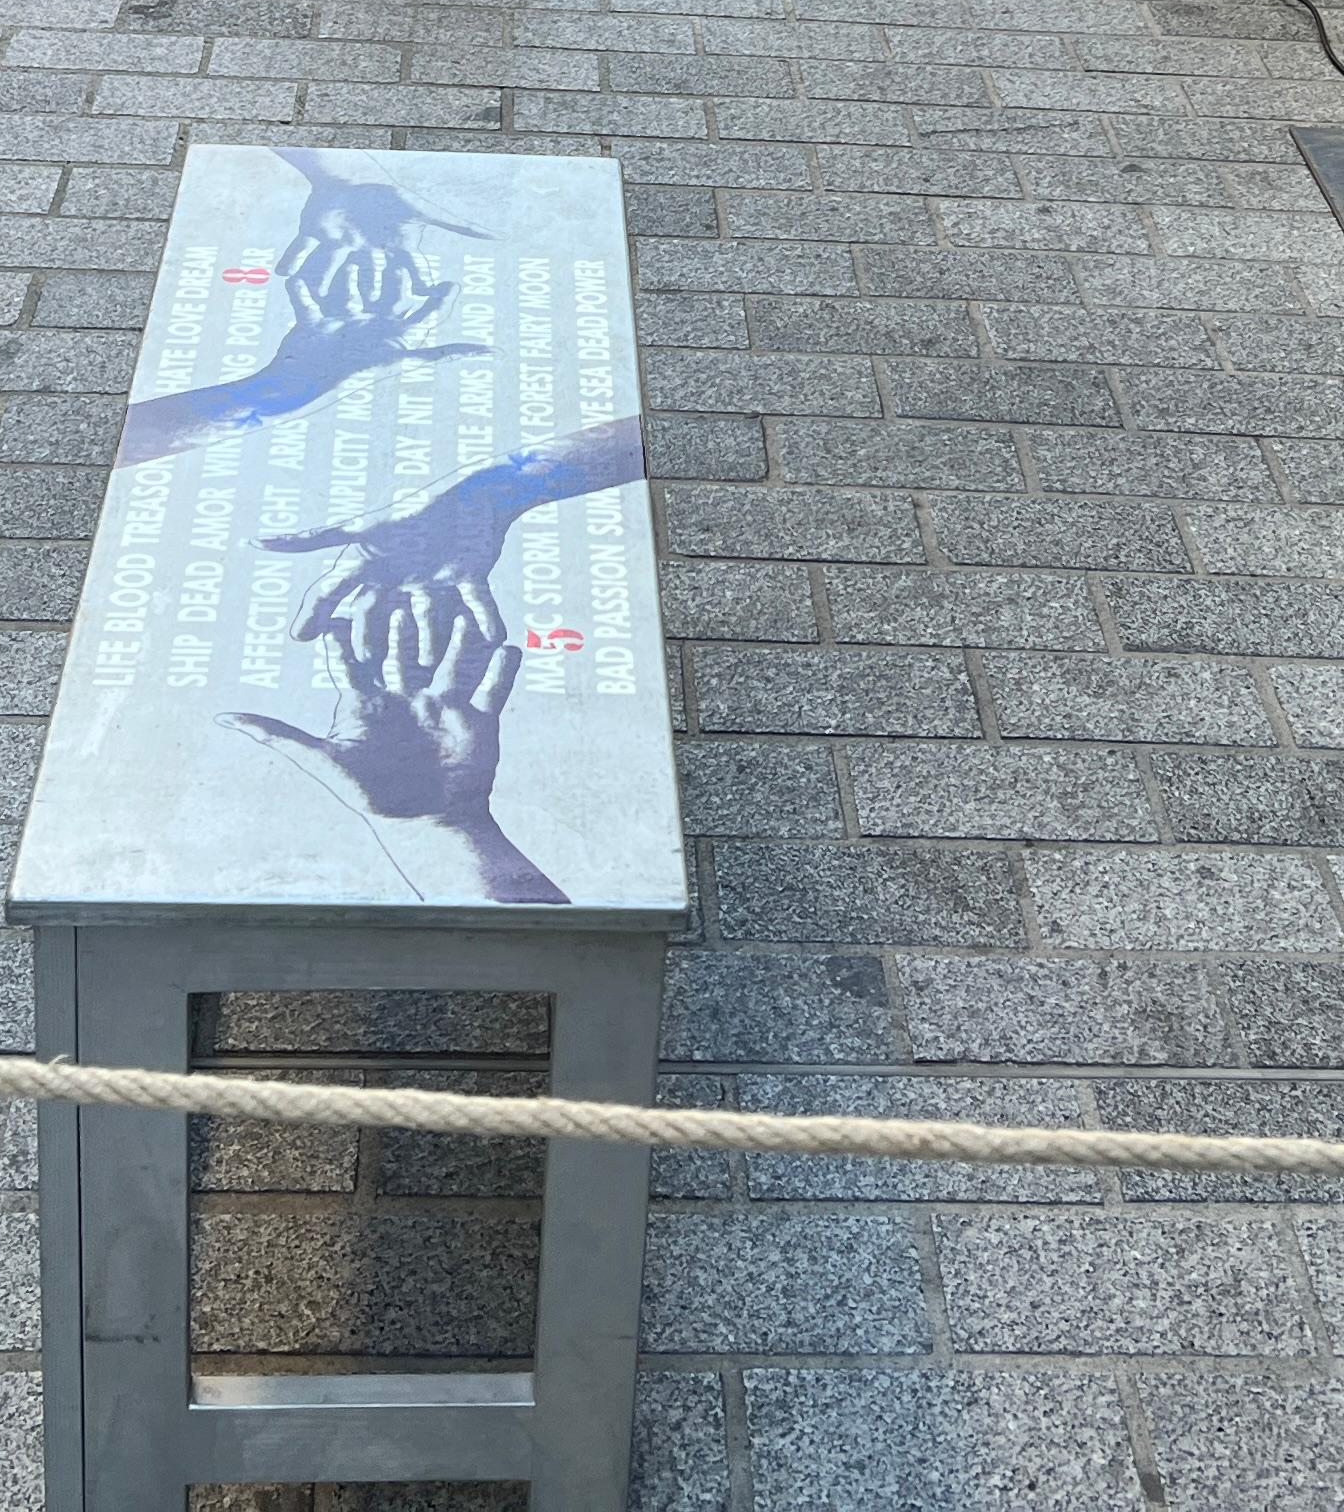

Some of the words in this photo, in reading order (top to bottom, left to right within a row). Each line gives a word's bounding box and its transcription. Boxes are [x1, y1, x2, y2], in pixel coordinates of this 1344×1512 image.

[177, 247, 219, 299] DREAM
[221, 267, 271, 286] 8
[461, 254, 497, 296] BOAT
[518, 257, 552, 309] MOON
[573, 259, 609, 315] POWER
[165, 303, 208, 345] LOVE
[224, 288, 269, 347] POWER
[518, 312, 553, 359] FAIRY
[575, 316, 611, 361] DEAD
[155, 349, 198, 393] HATE
[457, 368, 494, 418] ARMS
[518, 363, 555, 428] FOREST
[577, 366, 614, 399] SEA
[396, 392, 434, 425] NIT
[268, 419, 310, 472] ARMS
[393, 435, 433, 476] DAY
[325, 427, 373, 532] OMPLICITY
[189, 487, 237, 551] AMOR
[257, 483, 301, 535] IGHT
[103, 553, 155, 633] BLOOD
[176, 560, 225, 623] DEAD
[522, 531, 562, 606] STORM
[589, 543, 633, 640] PASSION
[239, 560, 293, 689] AFFECTION
[527, 628, 584, 652] 5
[92, 640, 143, 687] LIFE
[166, 634, 214, 688] SHIP
[594, 647, 638, 696] BAD
